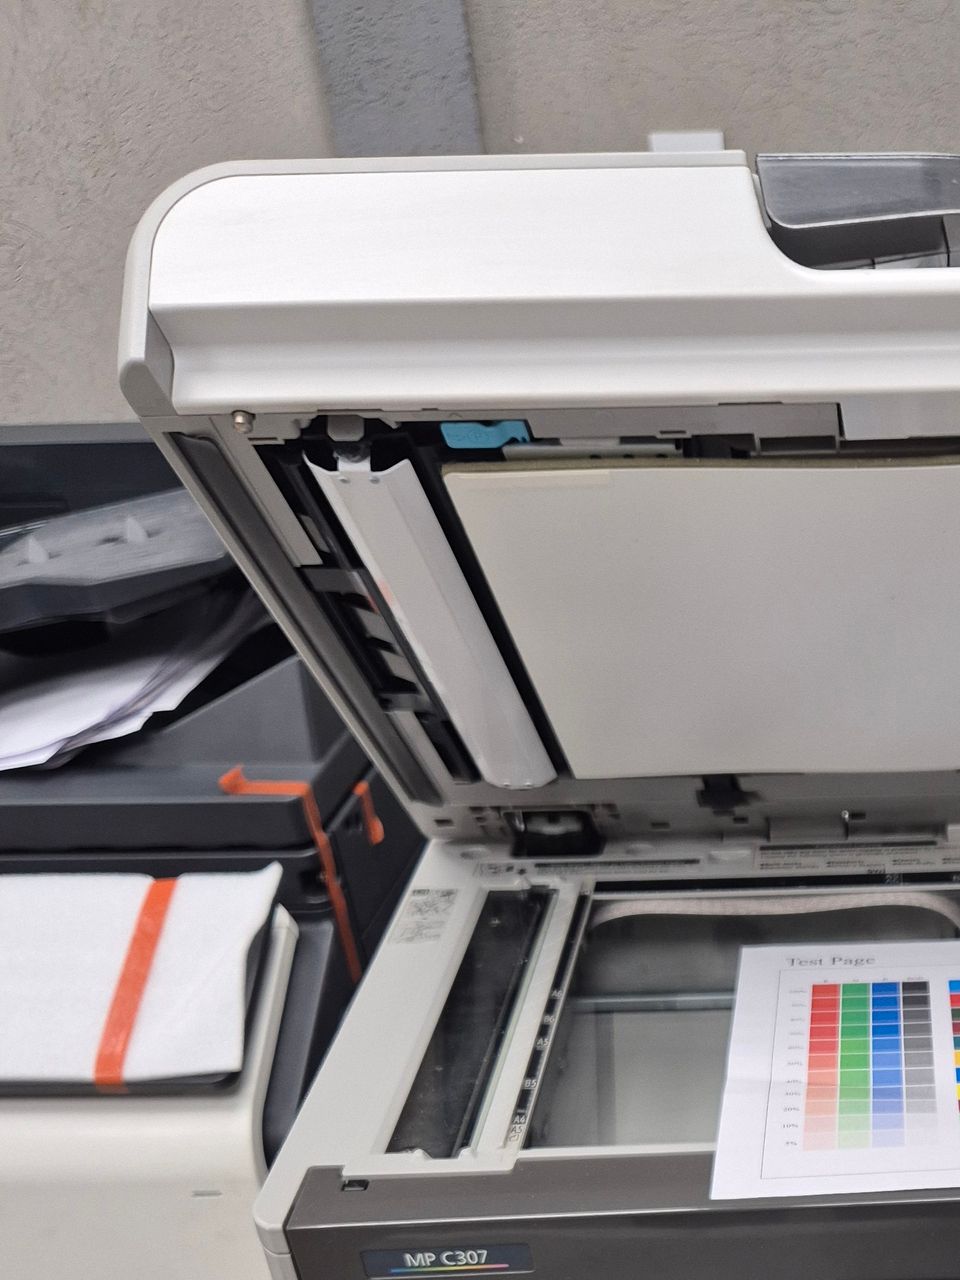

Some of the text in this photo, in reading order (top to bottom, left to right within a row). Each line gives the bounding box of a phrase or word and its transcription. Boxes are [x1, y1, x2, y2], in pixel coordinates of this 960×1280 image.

[787, 957, 876, 966] Test Page
[537, 1038, 549, 1046] A5
[524, 1079, 537, 1088] B5
[403, 1249, 488, 1267] MP C307
